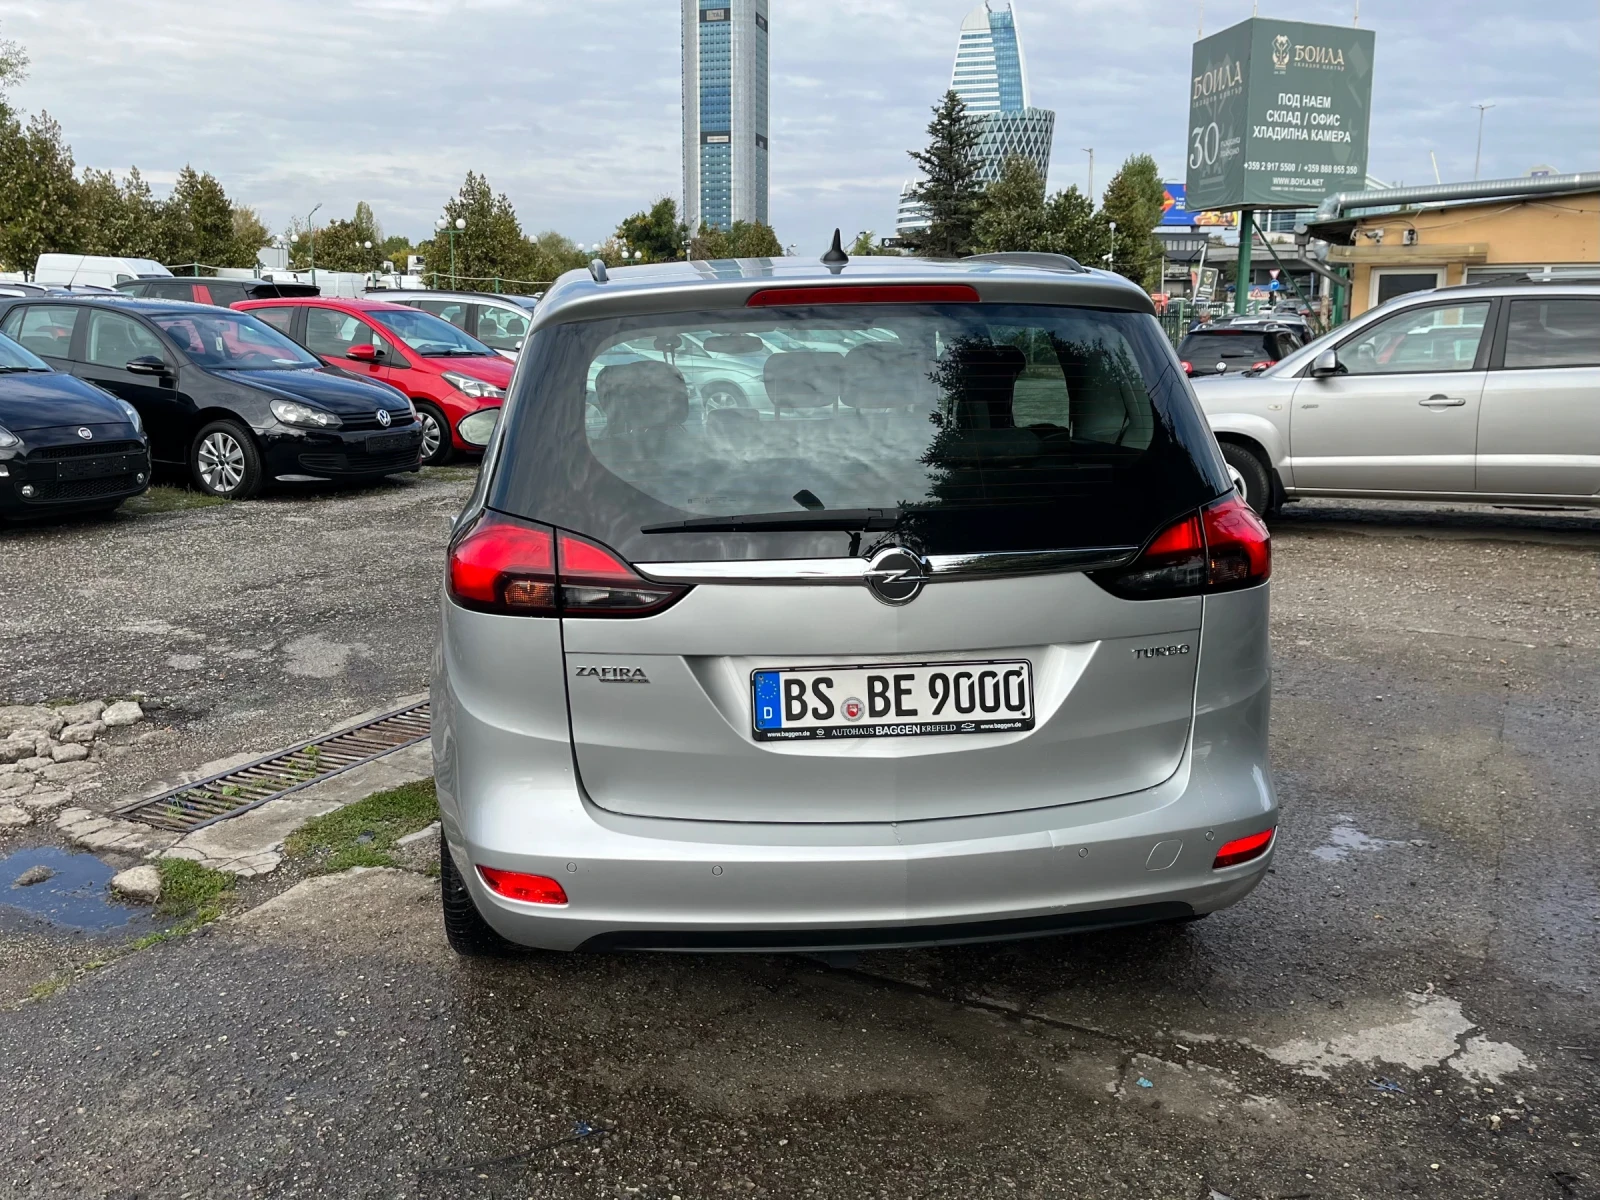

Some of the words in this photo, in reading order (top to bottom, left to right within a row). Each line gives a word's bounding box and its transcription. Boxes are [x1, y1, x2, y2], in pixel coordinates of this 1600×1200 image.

[1294, 45, 1344, 65] БОИЛА
[1193, 61, 1242, 99] БОИЛА
[1278, 93, 1300, 108] ПОД
[1302, 95, 1331, 108] НАЕМ
[1266, 110, 1300, 125] СКЛАД
[1303, 112, 1309, 126] /
[1310, 113, 1341, 126] ОФИС
[1253, 126, 1309, 141] ХЛАДИЛНА
[1311, 129, 1351, 143] КАМЕРА
[1189, 121, 1220, 169] 30
[1244, 161, 1260, 170] +359
[1261, 162, 1265, 170] 2
[1267, 162, 1279, 171] 917
[1280, 163, 1296, 172] 5500
[1304, 164, 1319, 173] +359
[1333, 165, 1345, 174] 955
[1346, 166, 1358, 174] 350
[1133, 644, 1190, 659] TURBO
[576, 665, 647, 678] ZAFIRA
[784, 677, 835, 721] BS
[867, 673, 918, 718] BE
[928, 669, 1026, 715] 9000
[763, 706, 773, 719] D
[767, 730, 810, 738] www.baggen.de
[831, 728, 875, 736] AUTOHAUS
[875, 724, 920, 735] BAGGEN
[921, 723, 957, 733] KREFELD
[980, 722, 1021, 730] www.baggen.de
